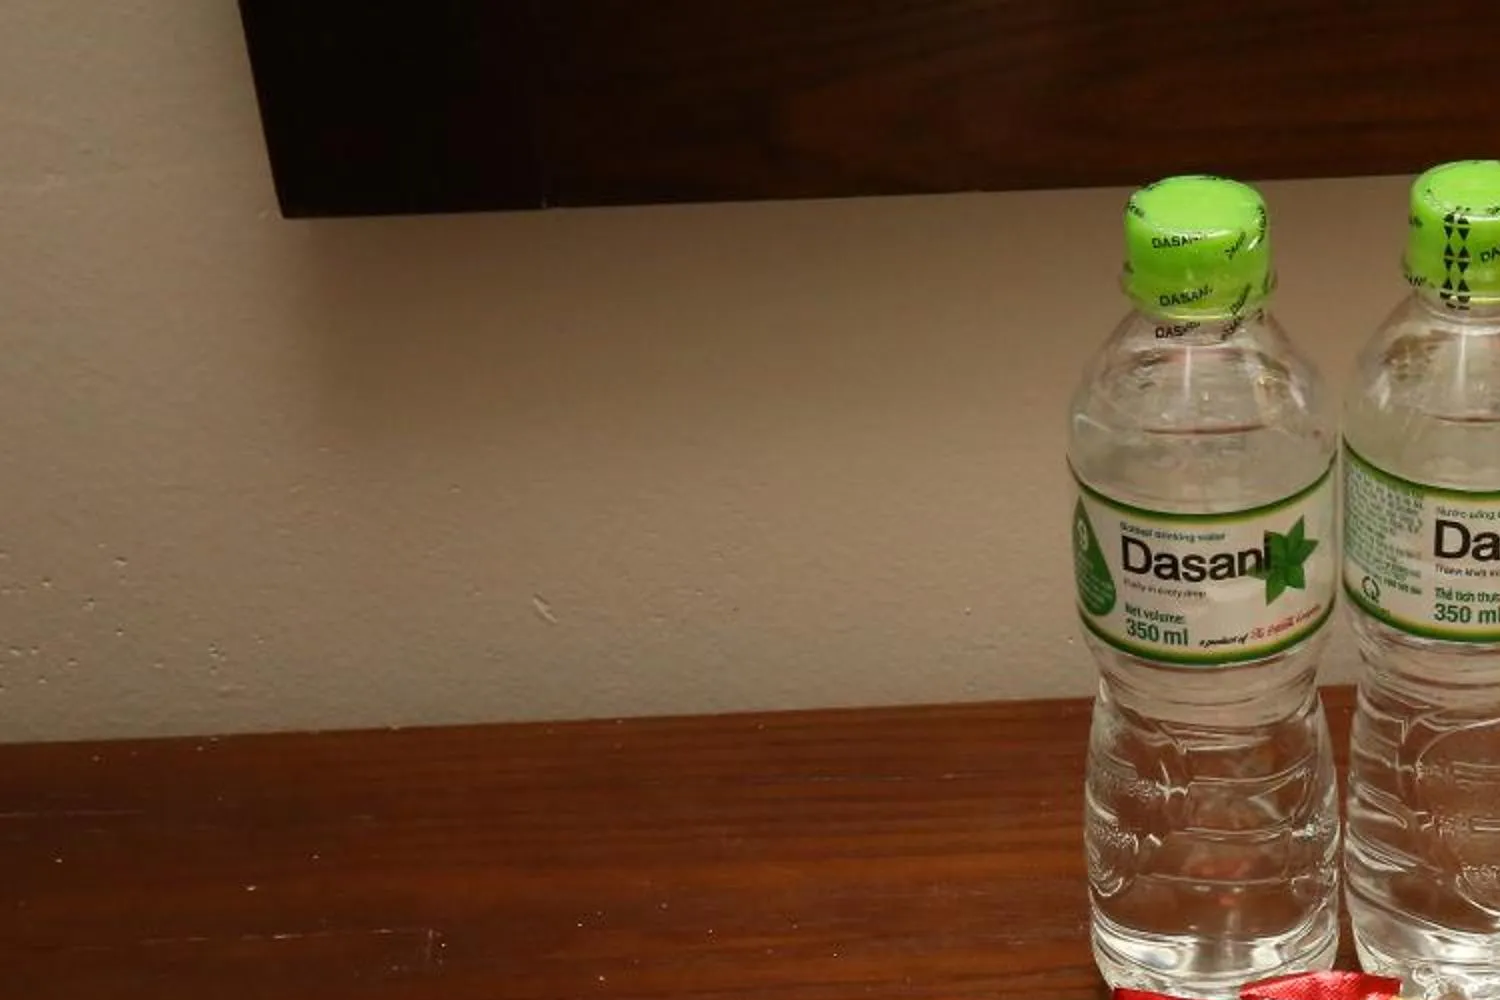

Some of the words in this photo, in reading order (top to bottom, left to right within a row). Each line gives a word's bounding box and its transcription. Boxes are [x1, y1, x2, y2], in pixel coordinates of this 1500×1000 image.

[1434, 603, 1472, 623] 350
[1125, 617, 1160, 643] 350
[1163, 629, 1189, 647] ml
